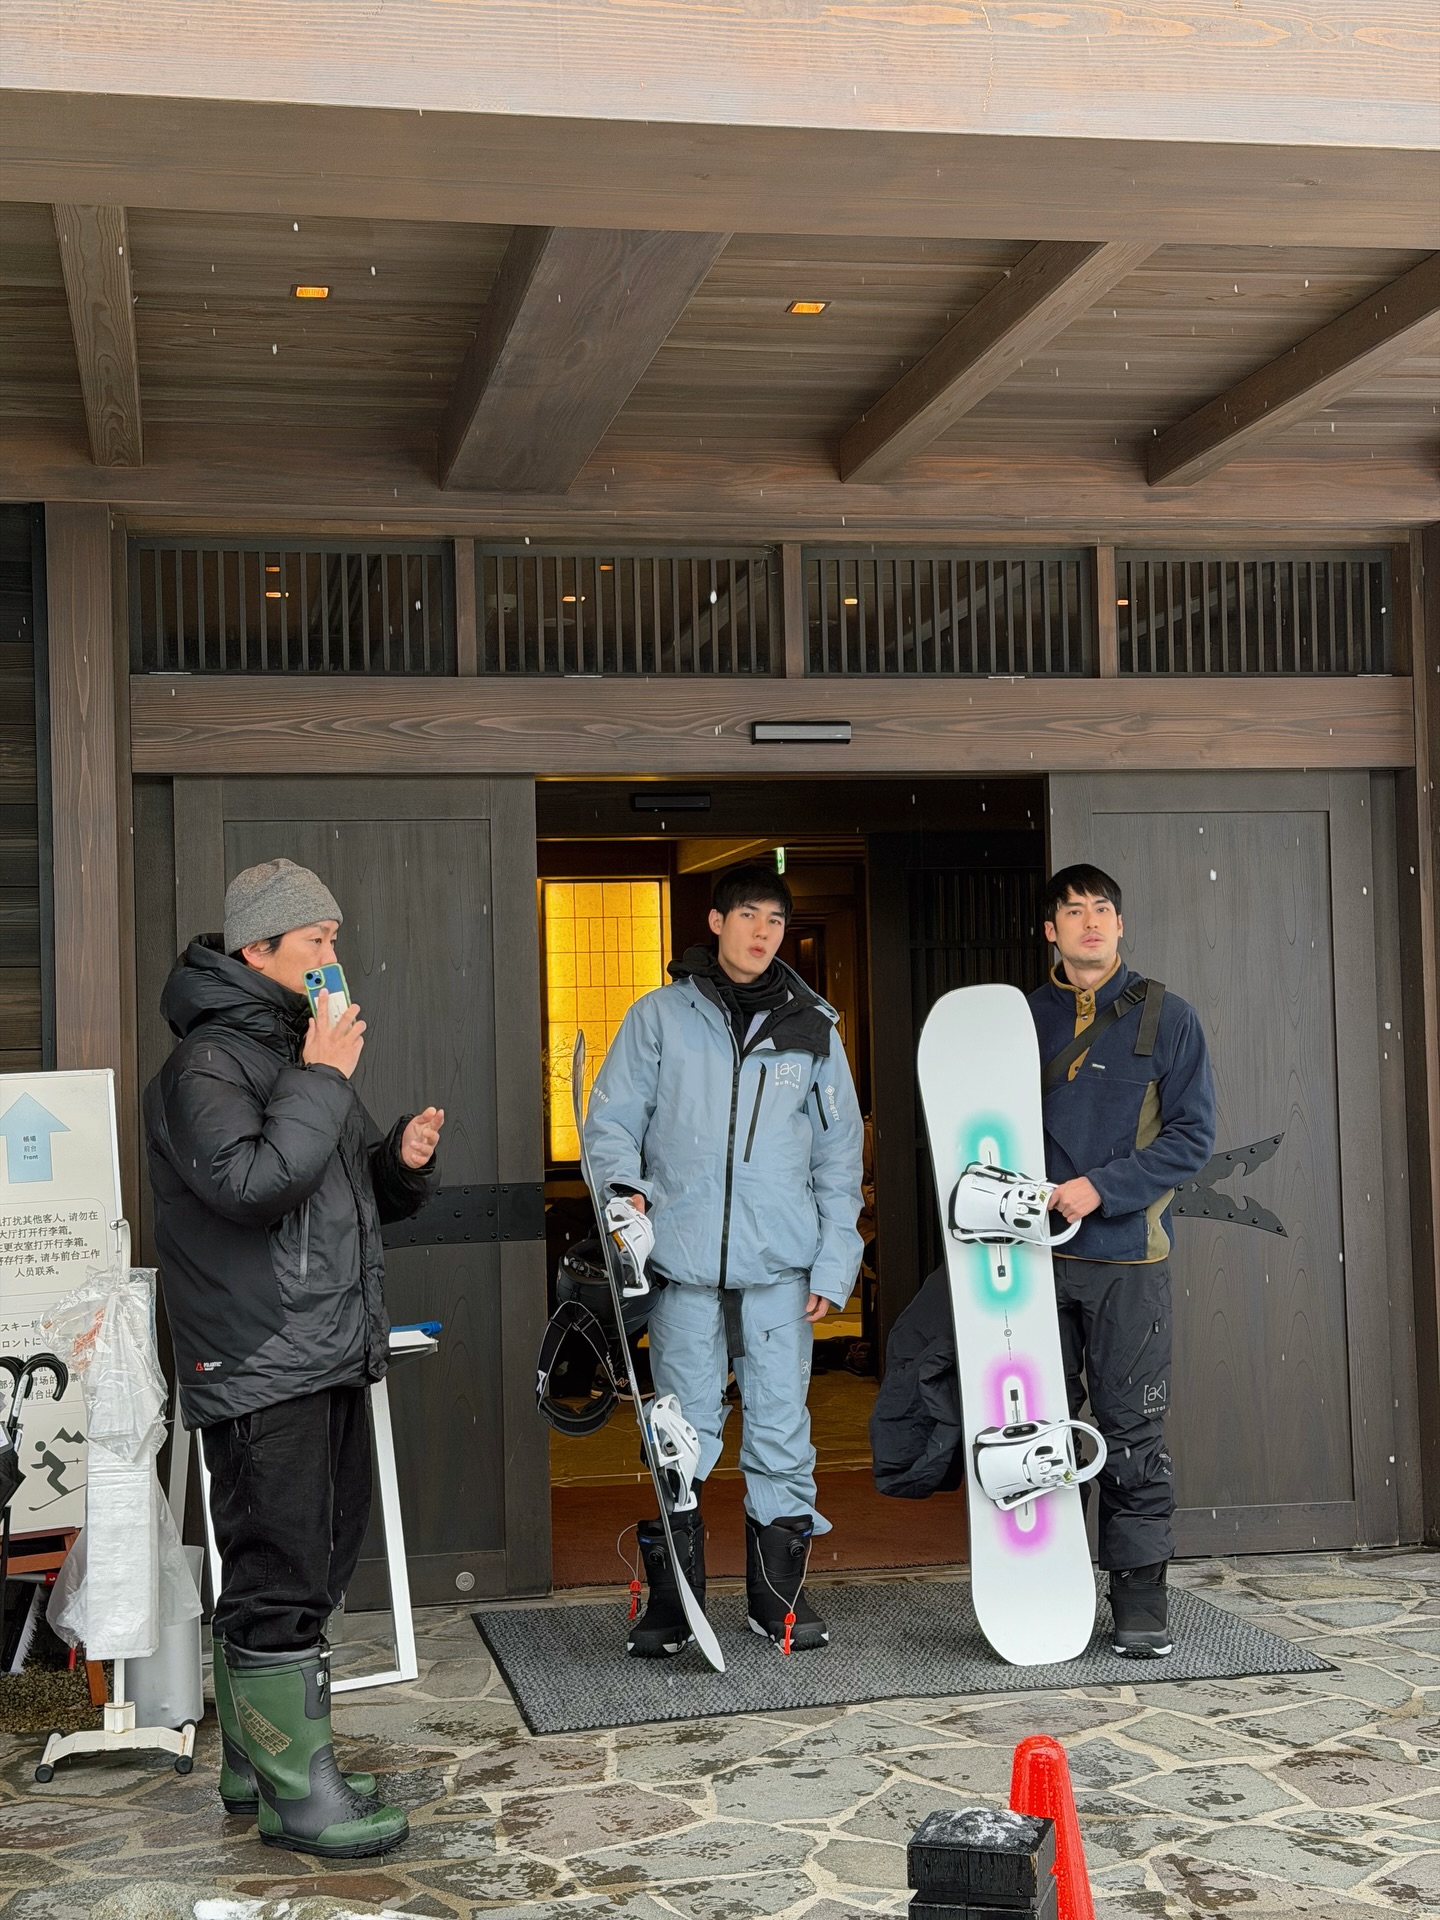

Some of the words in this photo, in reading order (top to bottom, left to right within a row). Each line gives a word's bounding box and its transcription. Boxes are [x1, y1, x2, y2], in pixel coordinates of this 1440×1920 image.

[775, 1079, 800, 1090] BURTON
[0, 1210, 99, 1227] 打扰其他客人，请勿在
[15, 1266, 60, 1278] 人员联系。
[2, 1337, 41, 1349] ロントに
